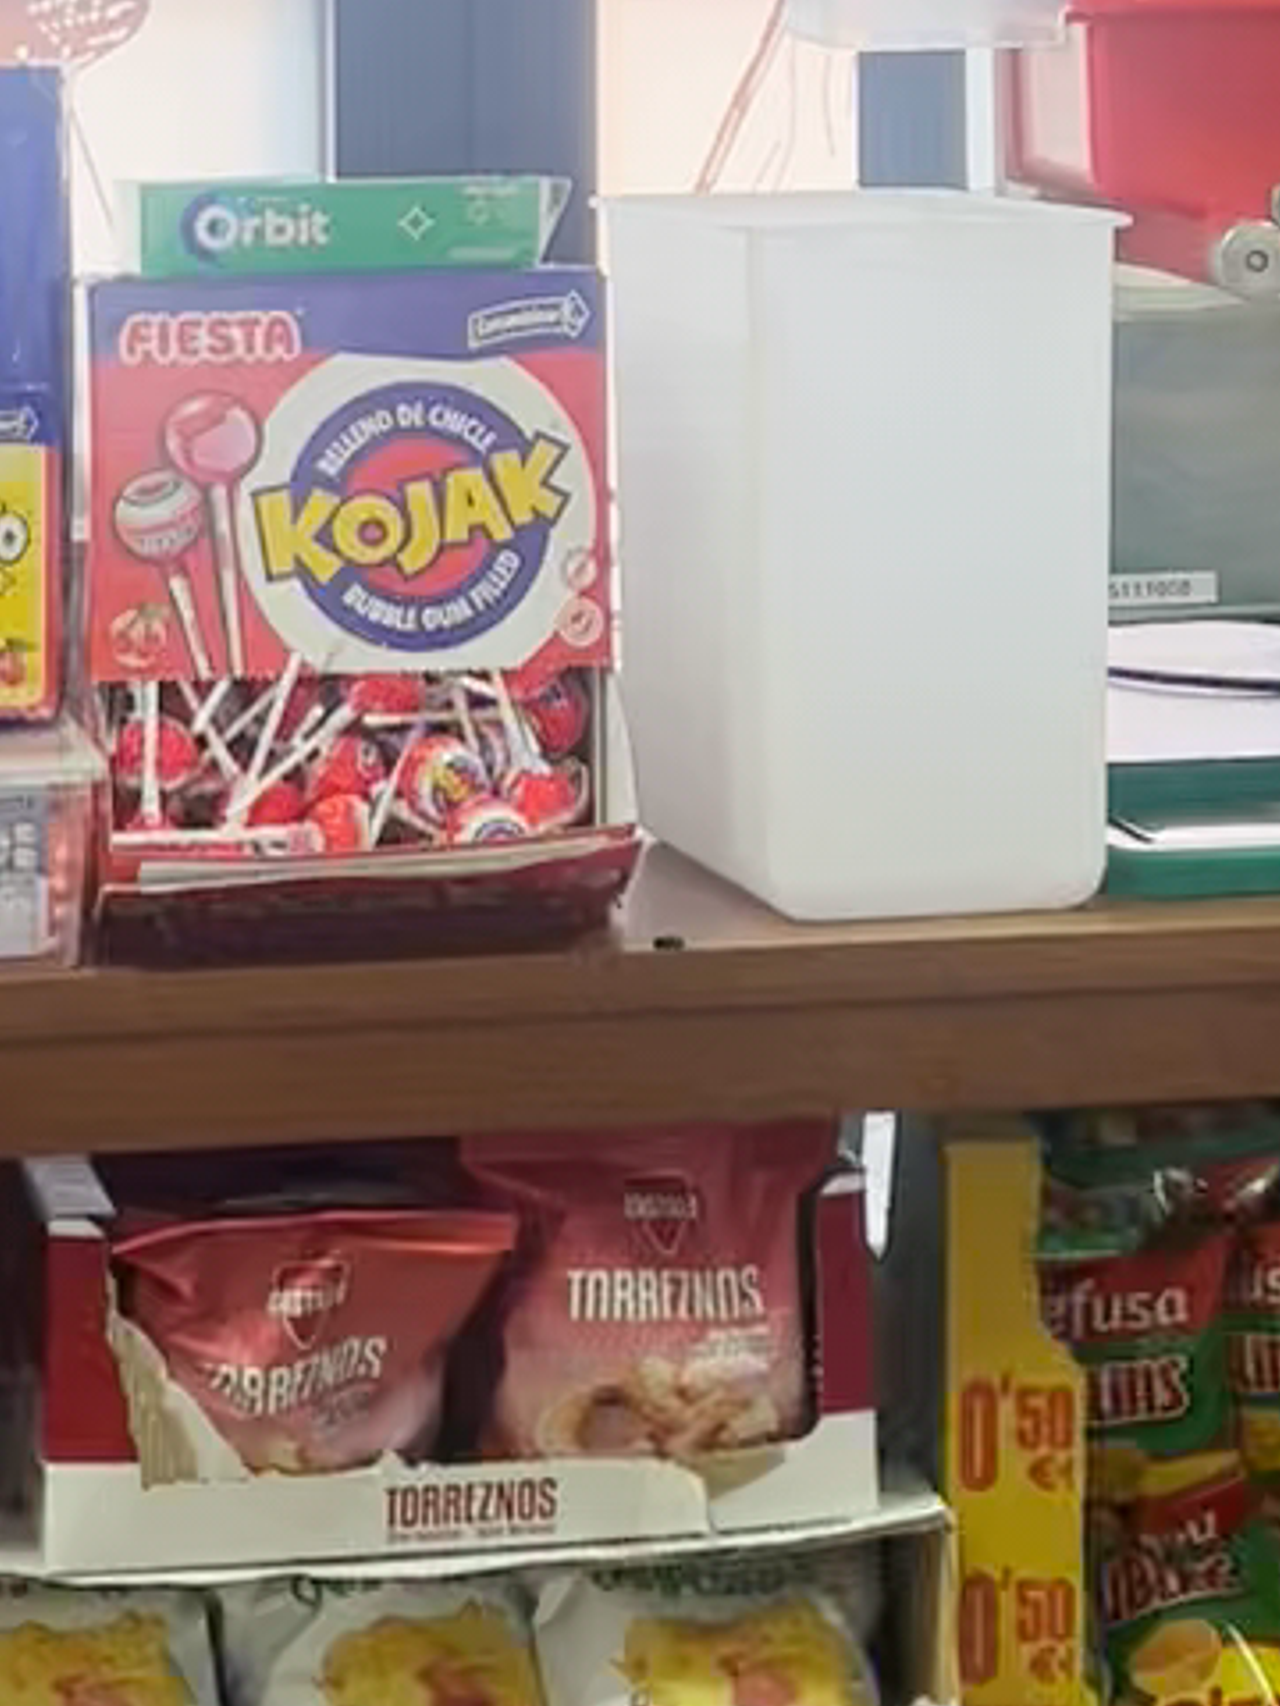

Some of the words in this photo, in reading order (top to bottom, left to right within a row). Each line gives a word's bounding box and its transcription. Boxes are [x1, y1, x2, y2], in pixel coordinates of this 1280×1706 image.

[195, 201, 331, 251] Orbit
[120, 309, 302, 365] FIESTA
[319, 409, 393, 477] RELLENO
[397, 401, 426, 430] DE
[428, 401, 498, 452] CHICLE
[252, 432, 571, 585] KOJAK
[342, 582, 419, 632] BUBBLE
[1047, 1278, 1189, 1340] efusa
[384, 1475, 560, 1529] TORREZNOS
